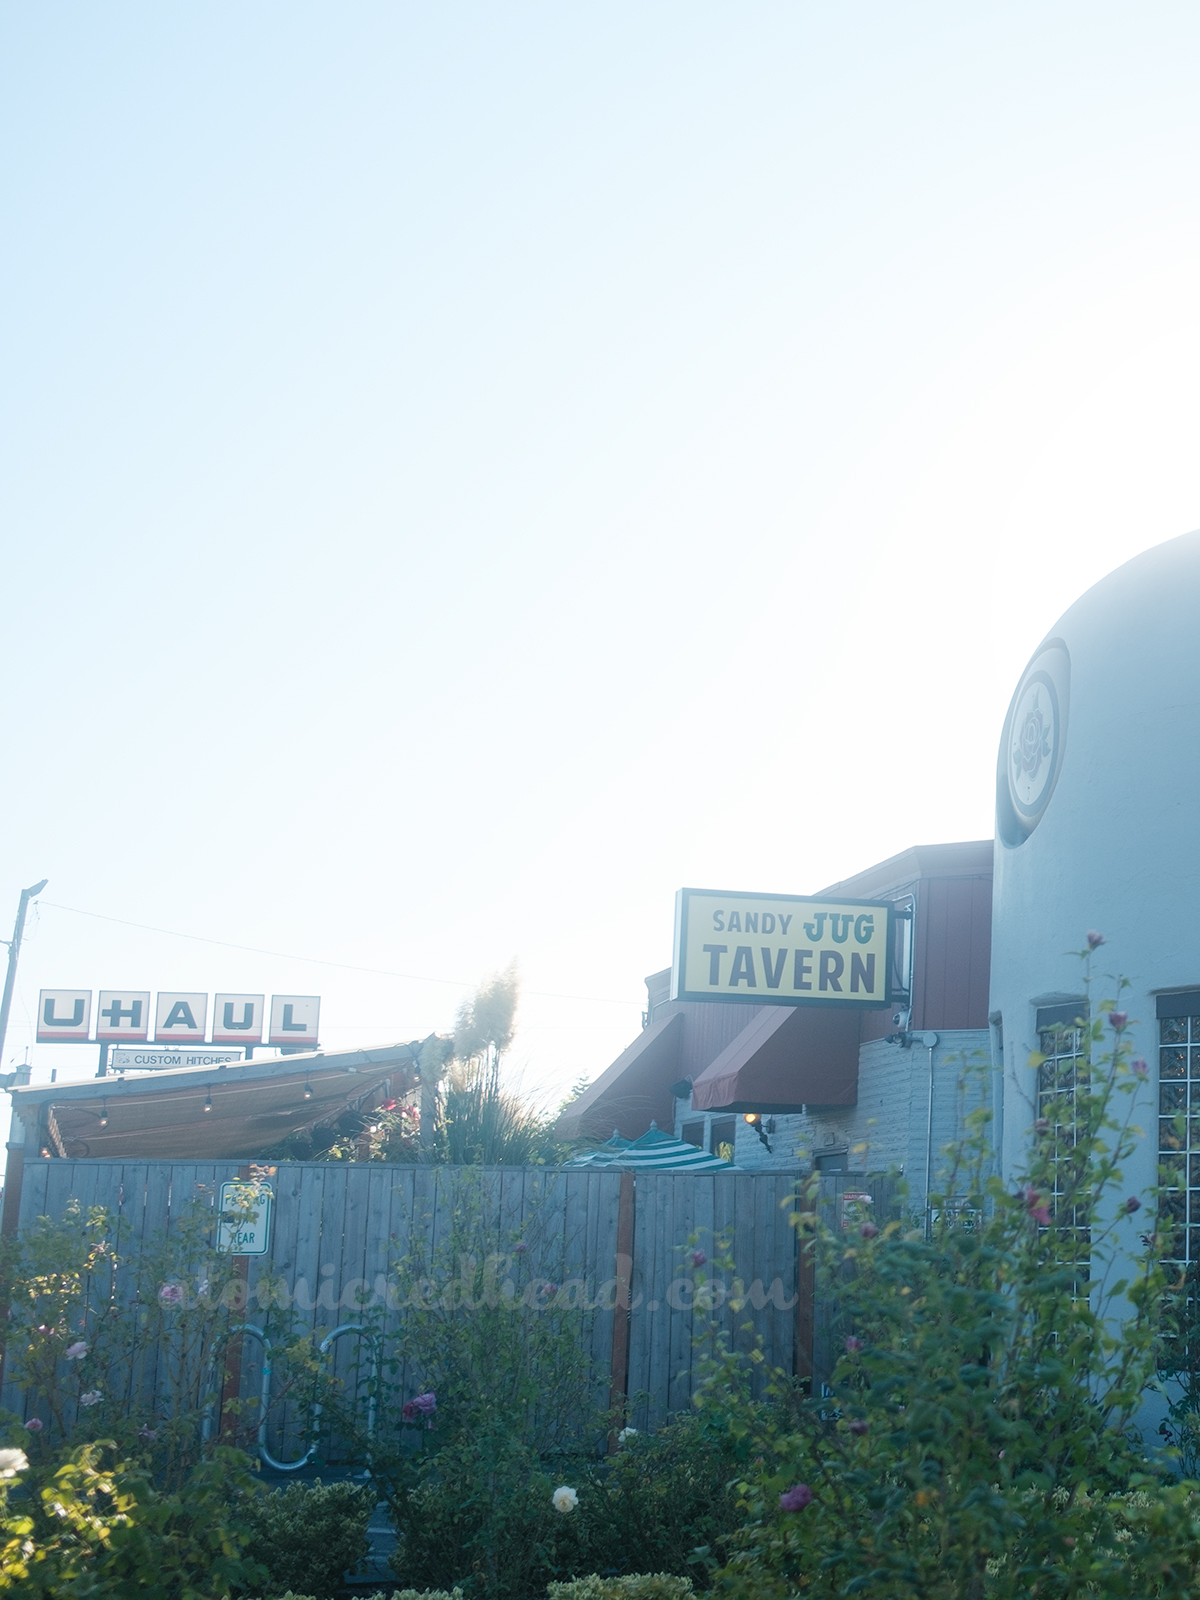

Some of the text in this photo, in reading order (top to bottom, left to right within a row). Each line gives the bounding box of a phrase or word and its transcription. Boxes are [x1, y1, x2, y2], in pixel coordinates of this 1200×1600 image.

[713, 909, 875, 944] SANDY JUG
[702, 944, 876, 994] TAVERN
[43, 998, 307, 1032] UHAUL
[134, 1055, 181, 1065] CUSTOM
